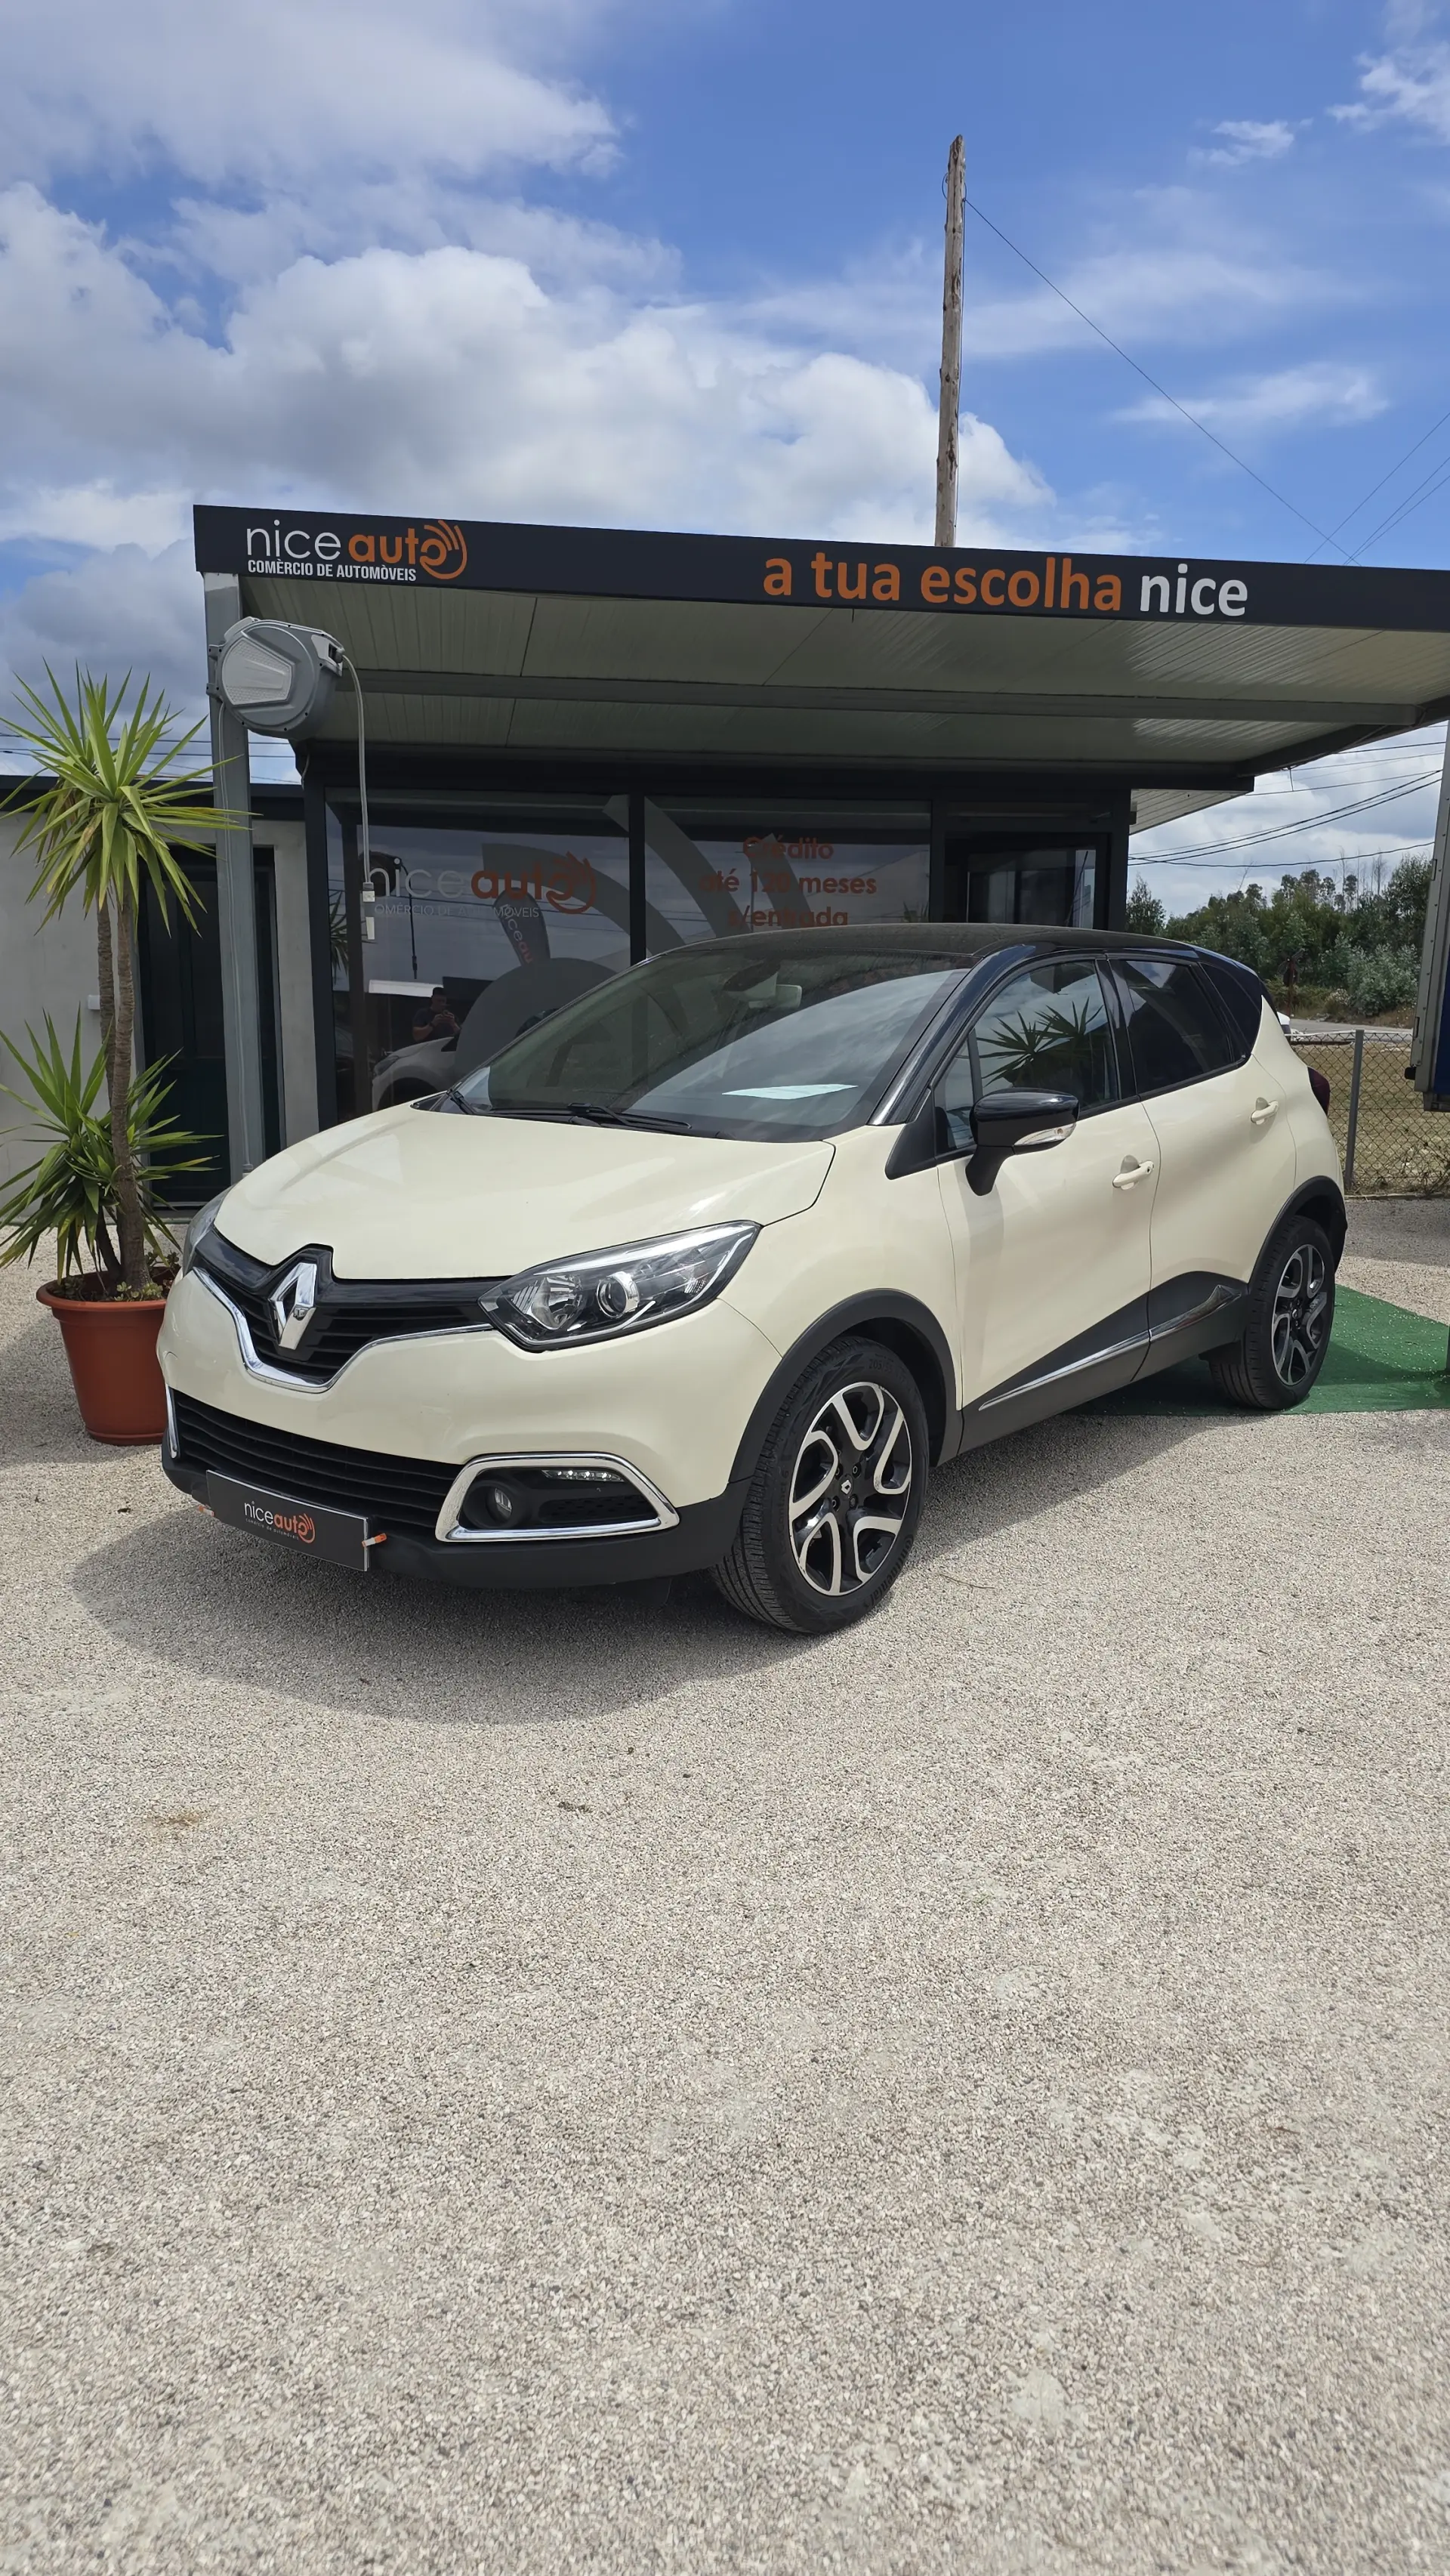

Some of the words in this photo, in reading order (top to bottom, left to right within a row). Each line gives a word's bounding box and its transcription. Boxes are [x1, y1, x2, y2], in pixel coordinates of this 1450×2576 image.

[316, 564, 333, 577] DE
[763, 558, 792, 597] a
[811, 552, 901, 601] tua
[921, 557, 1123, 612] escolha
[1140, 564, 1249, 617] nice
[742, 835, 835, 860] Crédito
[698, 869, 740, 893] até
[749, 869, 791, 894] 120
[798, 876, 878, 894] meses
[375, 901, 434, 916] OMÉRCIO
